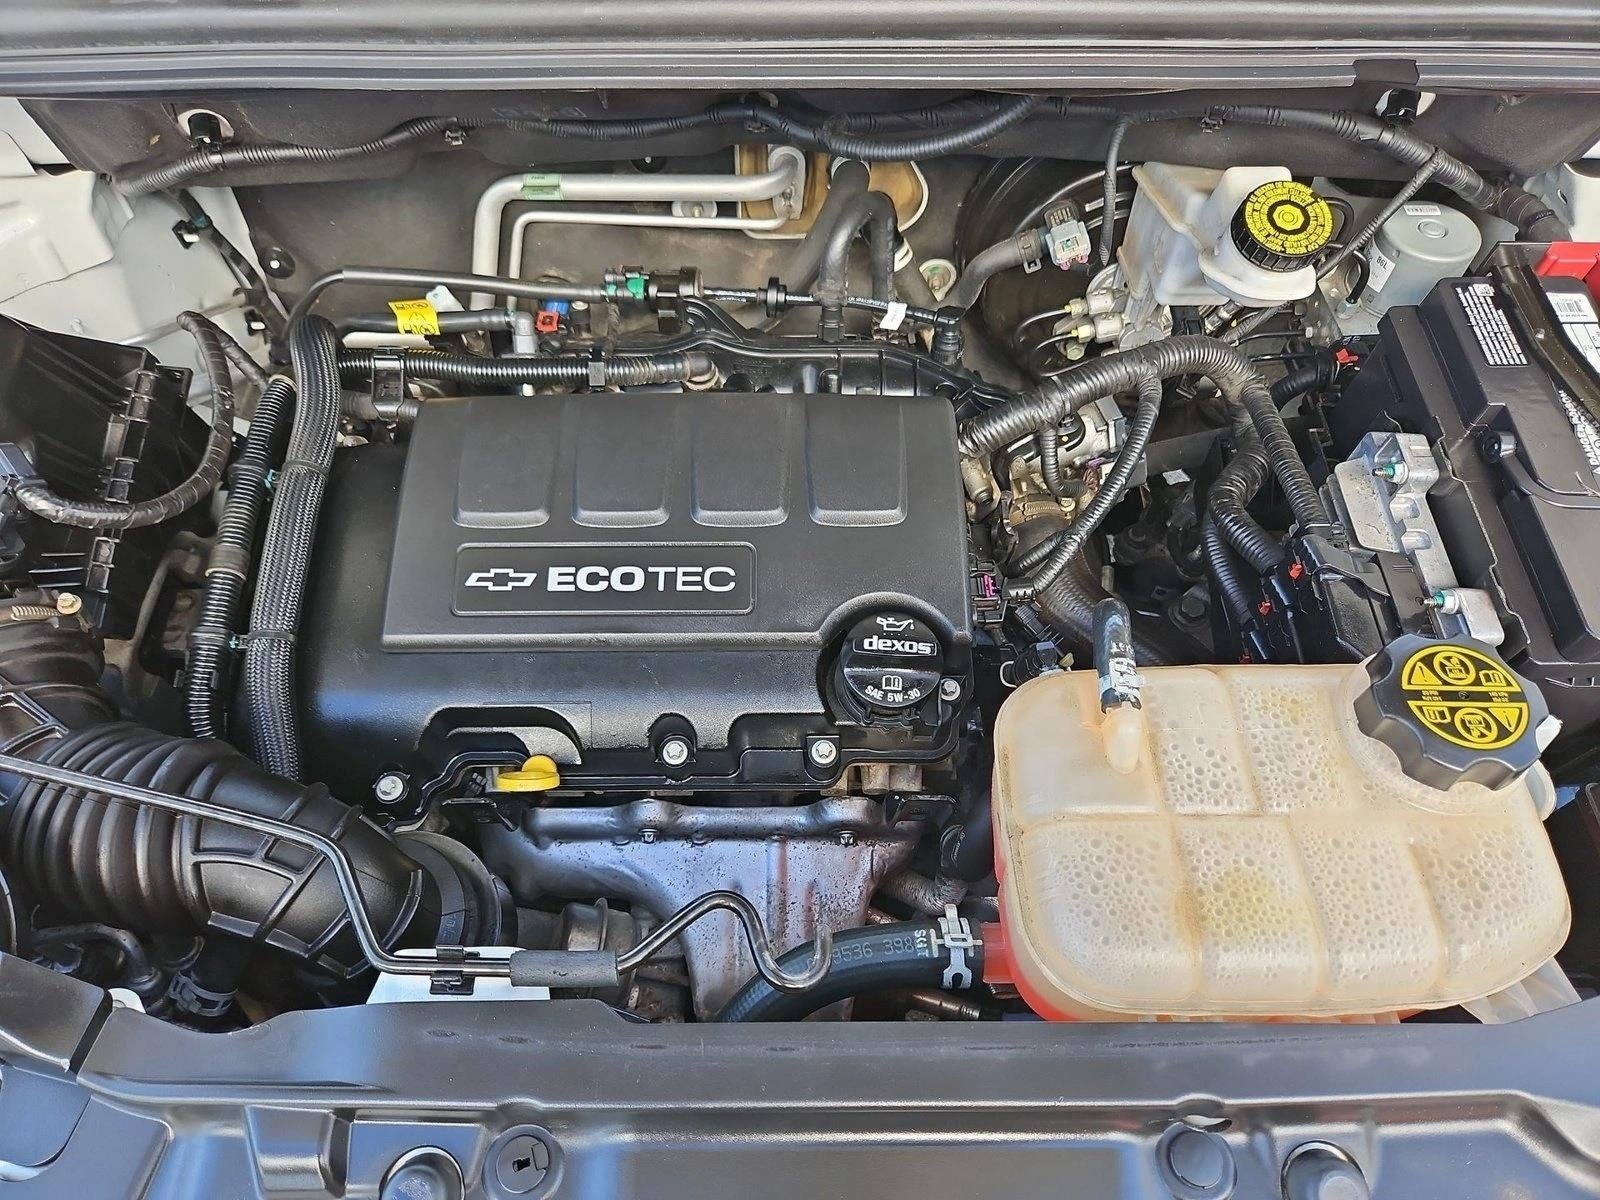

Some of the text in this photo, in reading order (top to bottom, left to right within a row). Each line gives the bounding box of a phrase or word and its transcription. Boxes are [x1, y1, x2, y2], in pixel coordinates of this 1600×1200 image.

[547, 565, 737, 592] ECOTEC
[863, 634, 935, 655] dexos
[865, 685, 921, 703] SAE 5W-30
